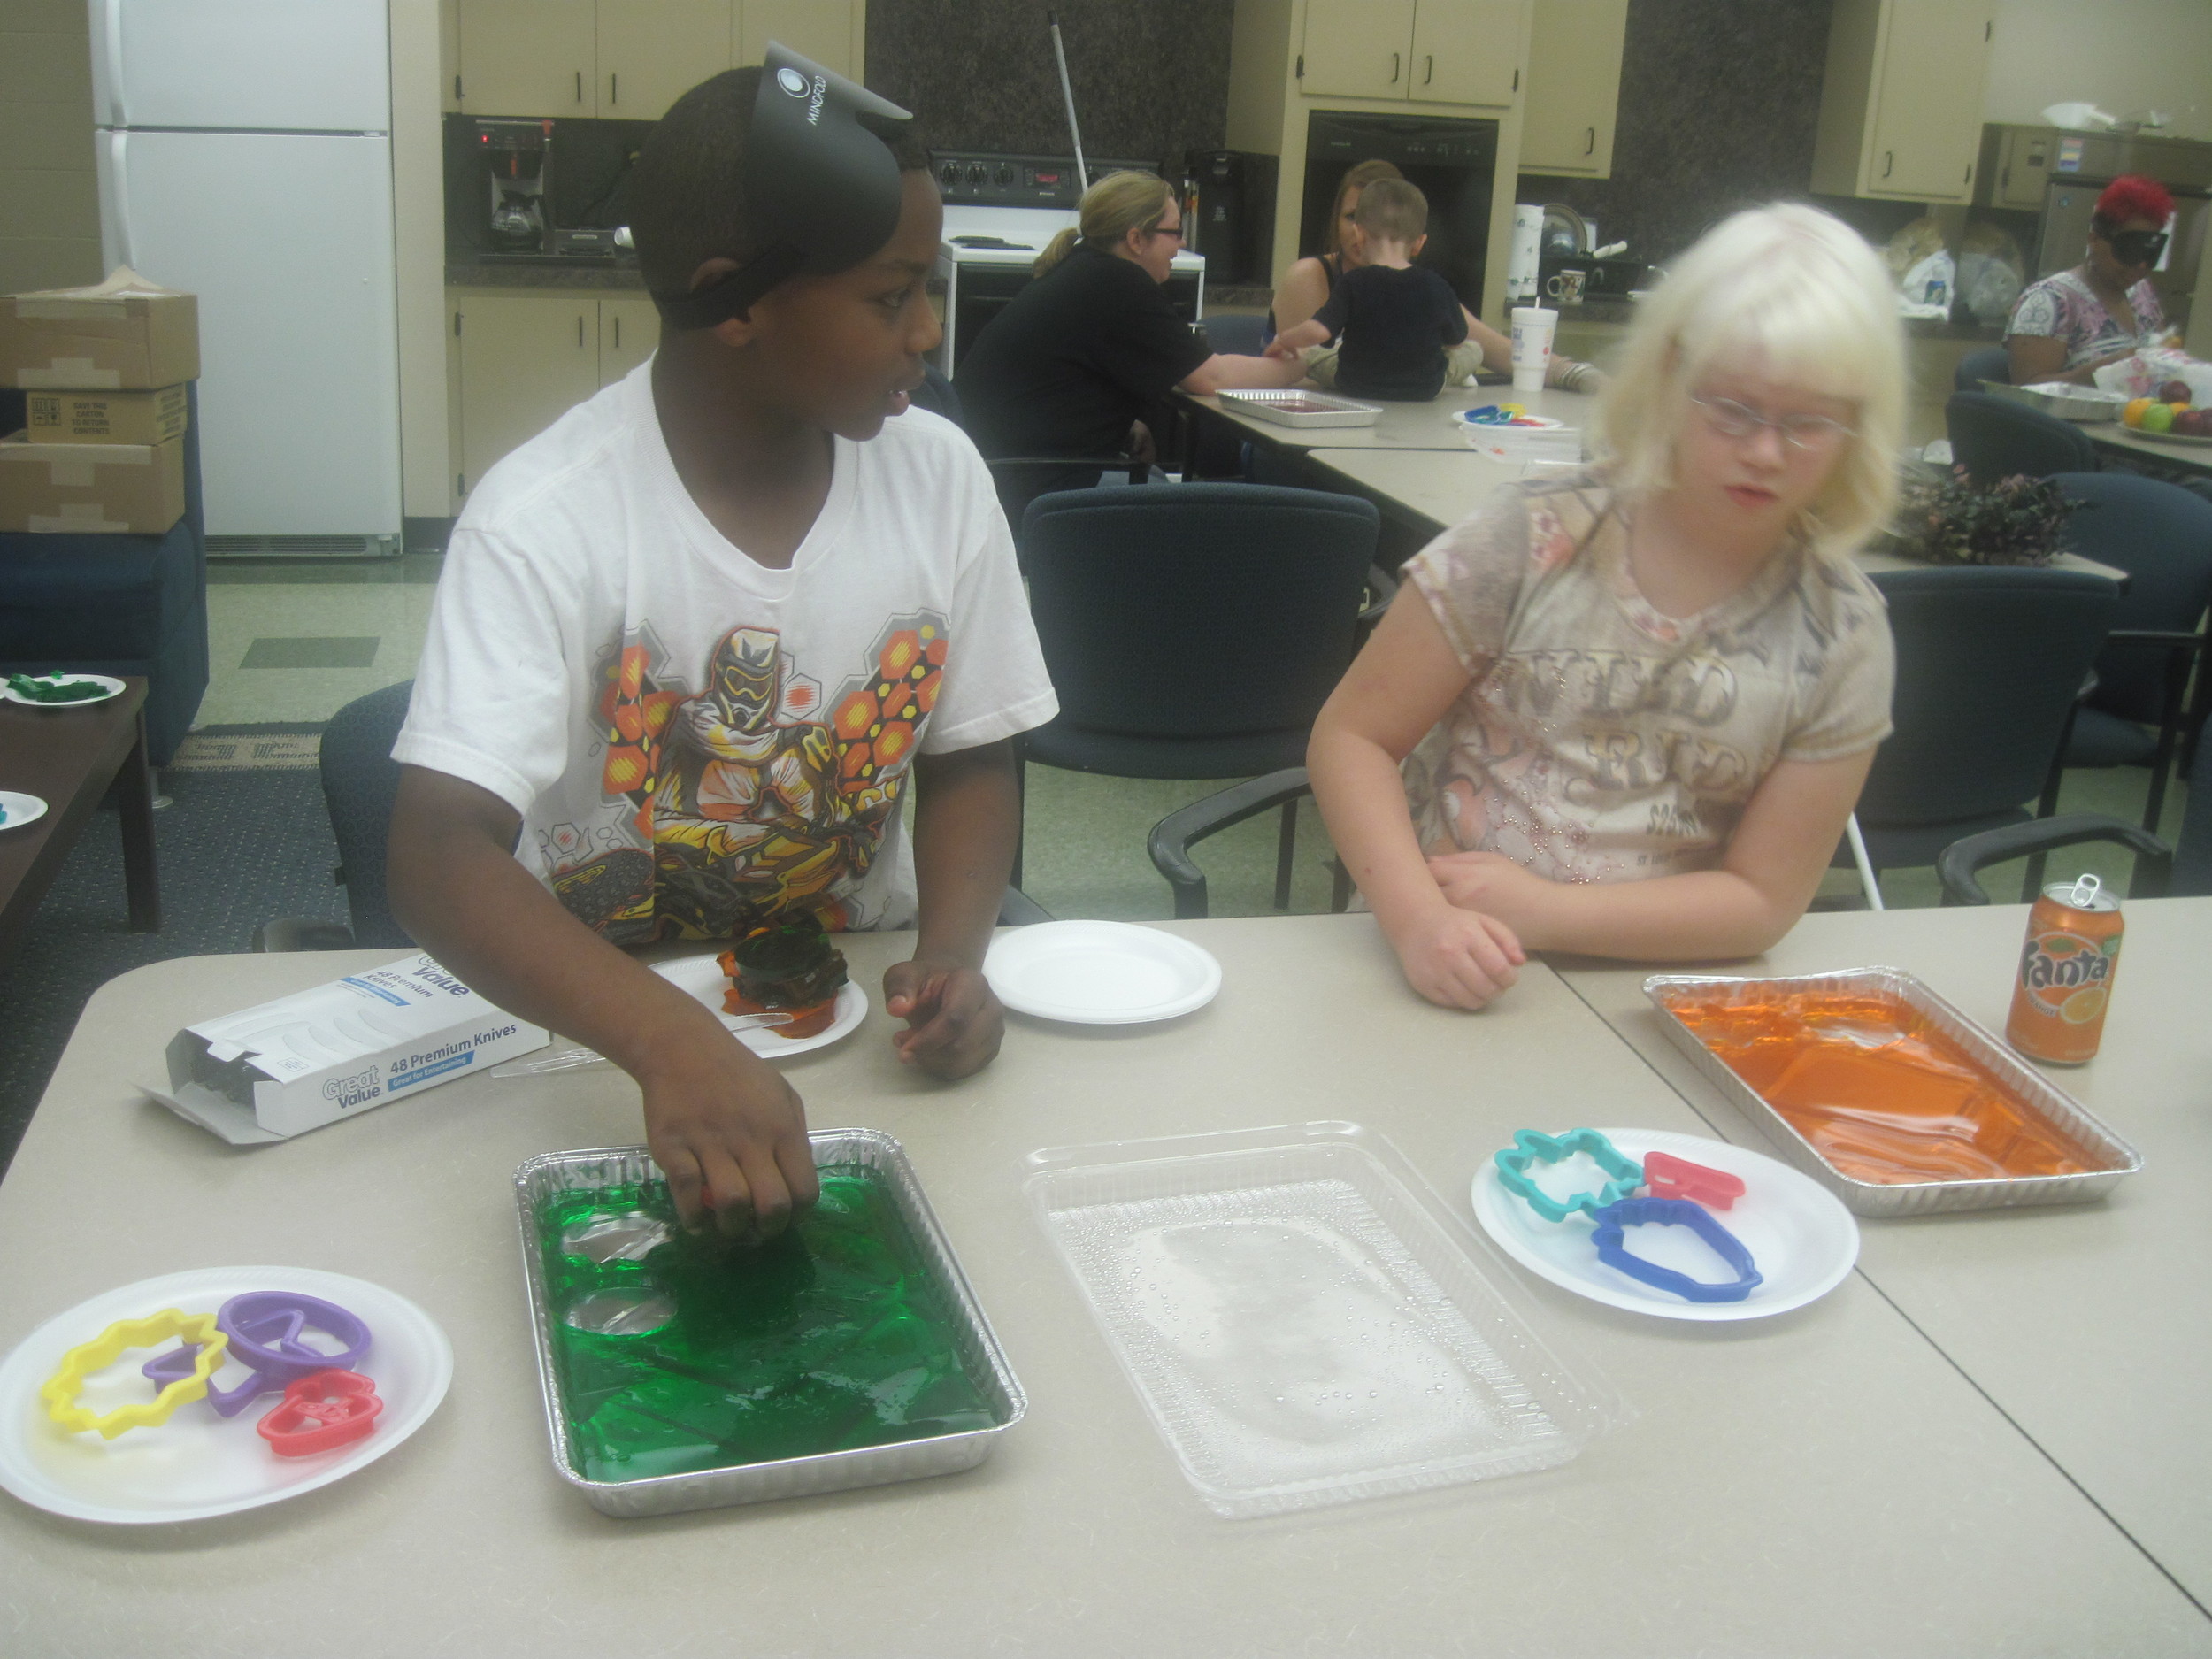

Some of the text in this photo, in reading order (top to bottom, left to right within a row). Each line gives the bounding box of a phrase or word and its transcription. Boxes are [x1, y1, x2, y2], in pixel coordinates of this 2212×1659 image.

[807, 75, 826, 126] MINDFOLD
[362, 974, 397, 989] Knives
[390, 972, 434, 998] Premium
[412, 966, 470, 996] Value
[390, 1023, 517, 1074] 48 Premium Knives
[322, 1065, 380, 1101] Great
[392, 1056, 467, 1087] Great for Entertaining
[337, 1087, 381, 1109] Value
